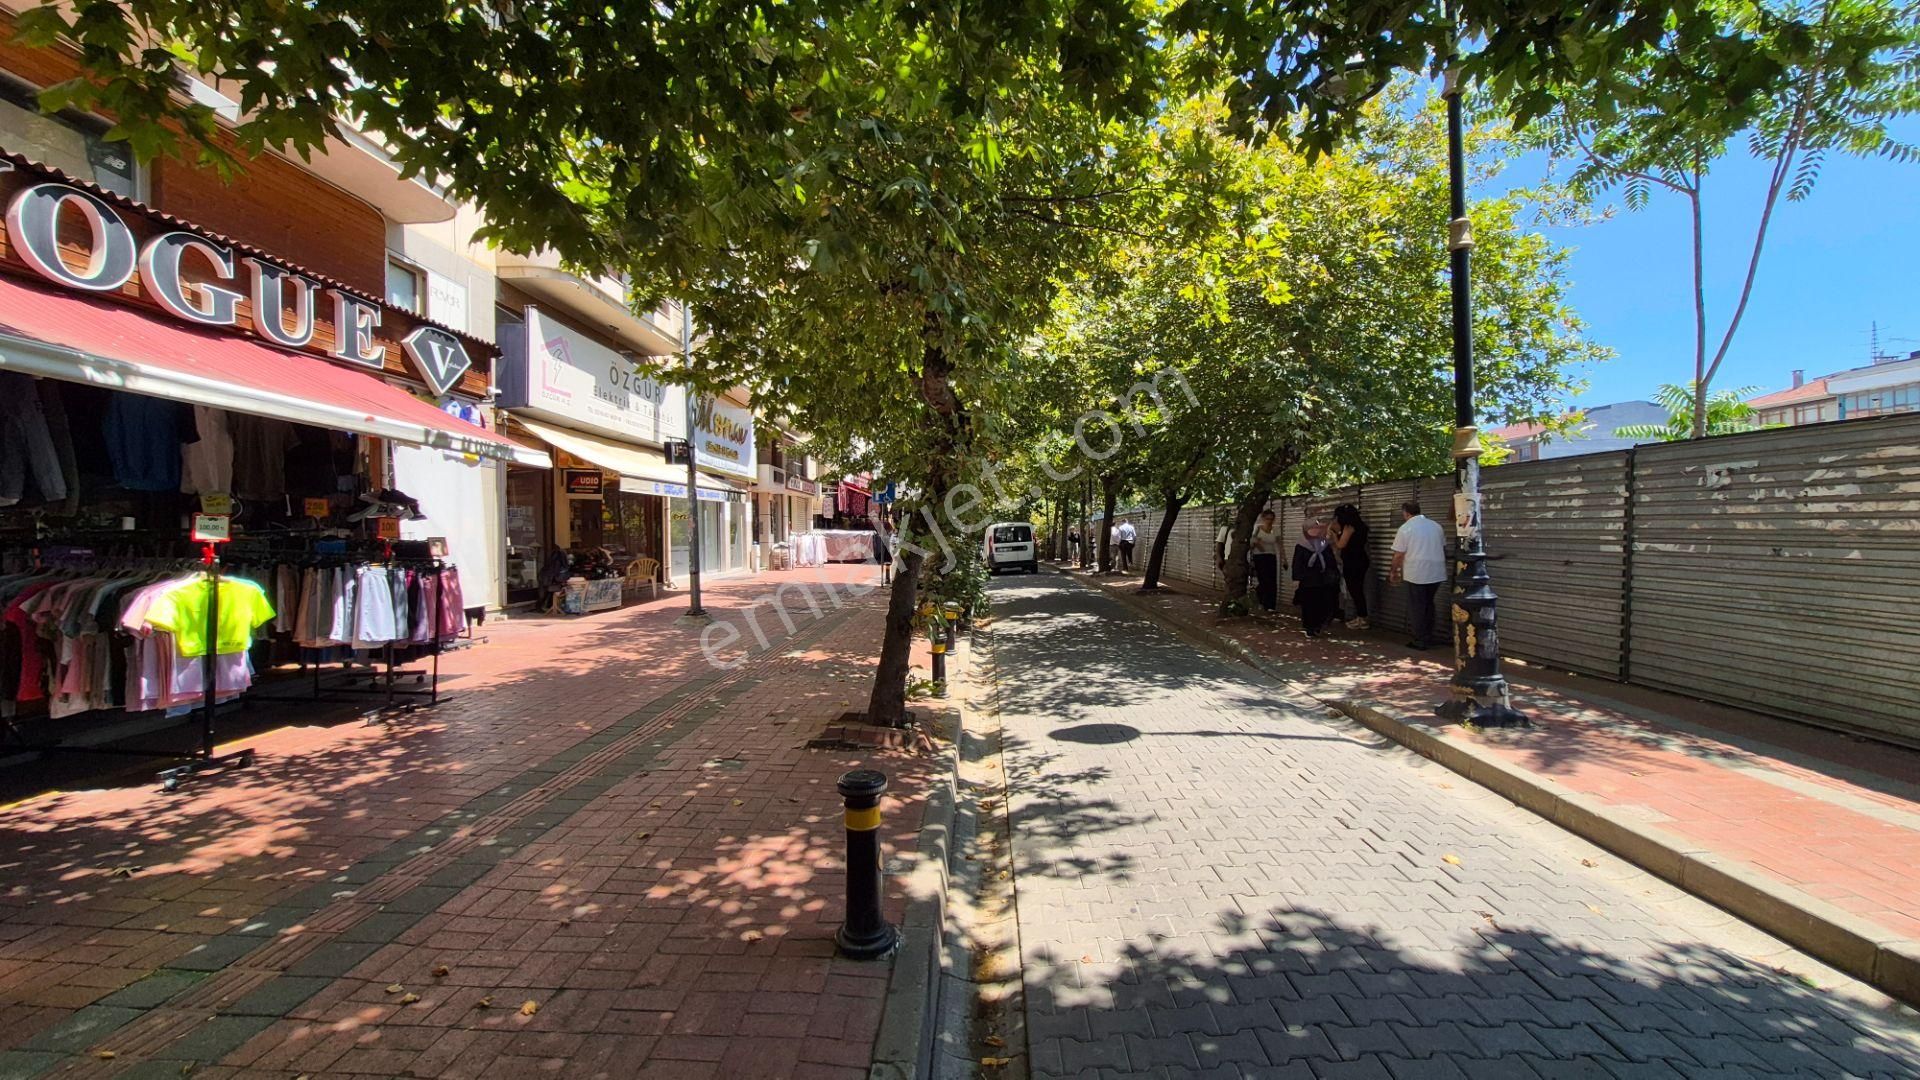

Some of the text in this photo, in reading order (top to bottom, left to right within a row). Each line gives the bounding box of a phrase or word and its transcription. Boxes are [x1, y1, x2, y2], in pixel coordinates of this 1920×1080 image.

[0, 159, 387, 369] OGUE
[428, 340, 455, 380] V
[609, 360, 662, 404] ÖZGÜR
